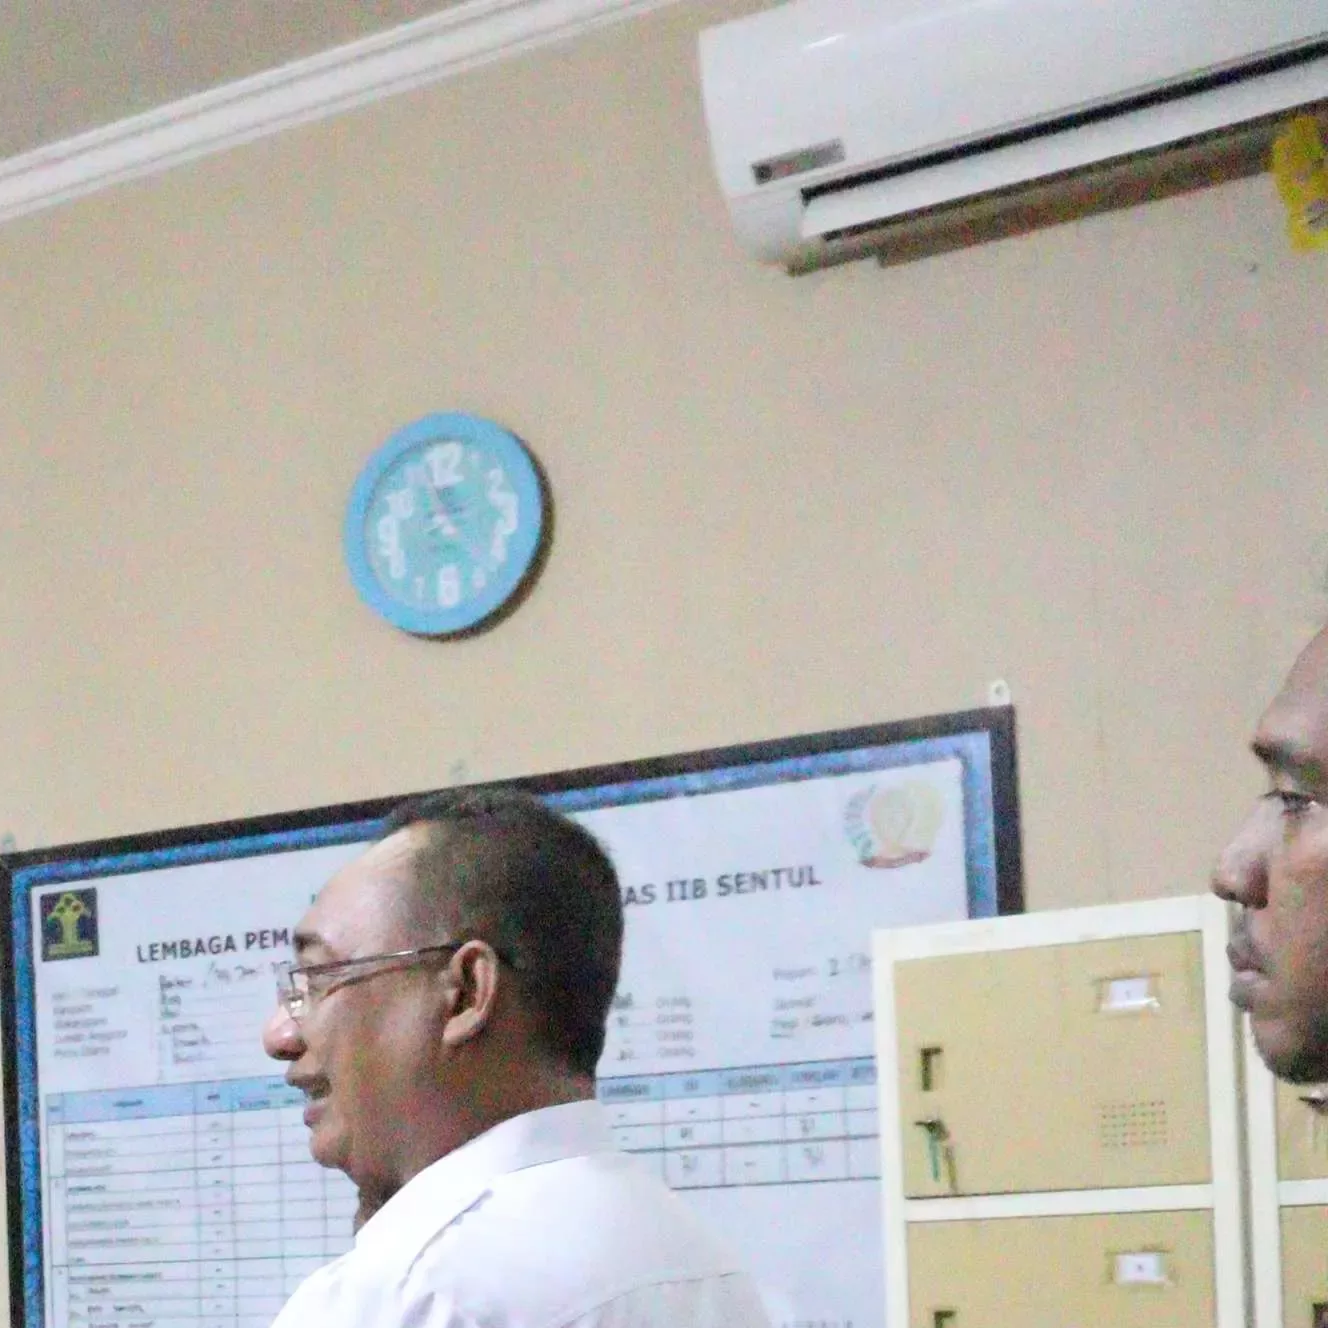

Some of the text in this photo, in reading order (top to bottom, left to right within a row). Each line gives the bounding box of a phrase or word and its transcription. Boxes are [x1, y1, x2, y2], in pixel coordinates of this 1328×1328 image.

[624, 864, 824, 906] AS IIB SENTUL
[136, 926, 296, 964] LEMBAGA PEM
